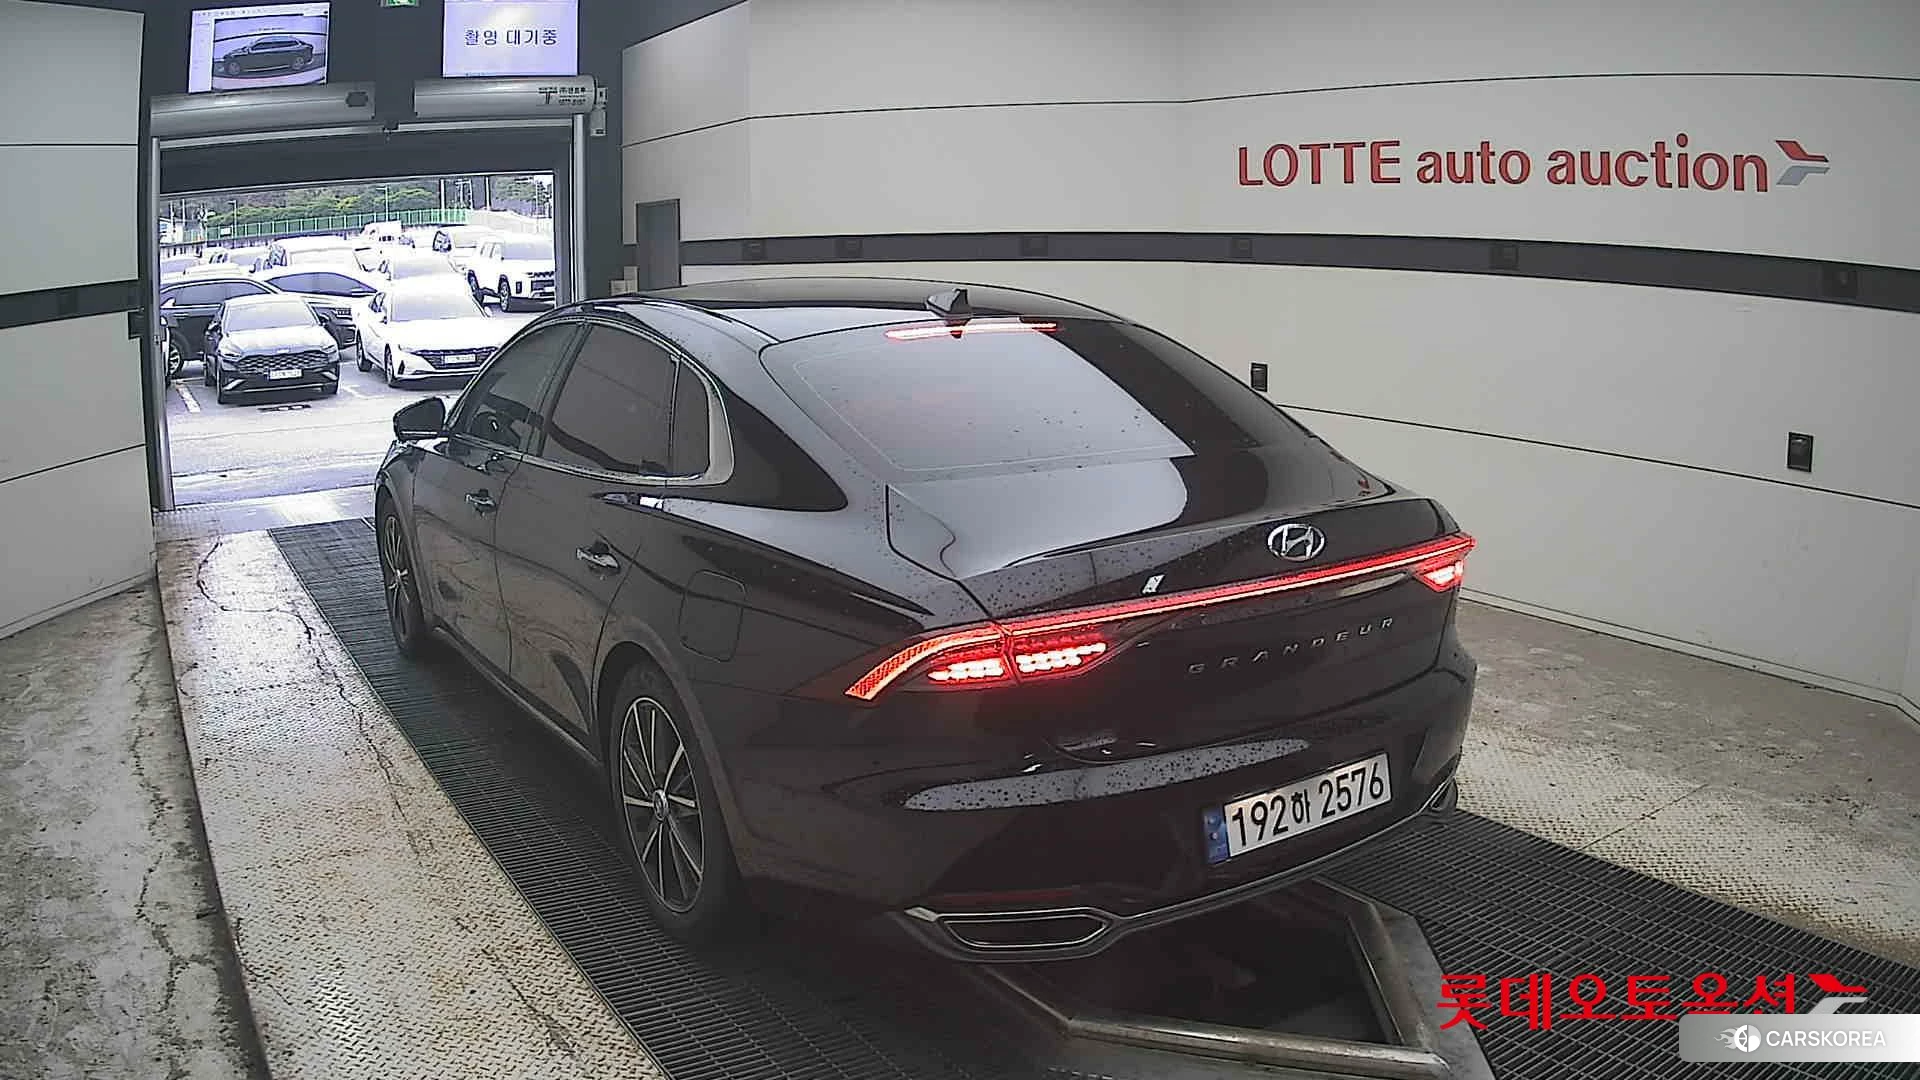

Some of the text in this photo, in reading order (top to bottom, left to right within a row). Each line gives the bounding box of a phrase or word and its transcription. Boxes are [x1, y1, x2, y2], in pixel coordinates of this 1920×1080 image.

[465, 28, 557, 46] 촬영 대기중
[1238, 133, 1768, 192] LOTTE auto auction
[1188, 616, 1394, 674] GRANDEUR
[1231, 762, 1385, 847] 192하 2576
